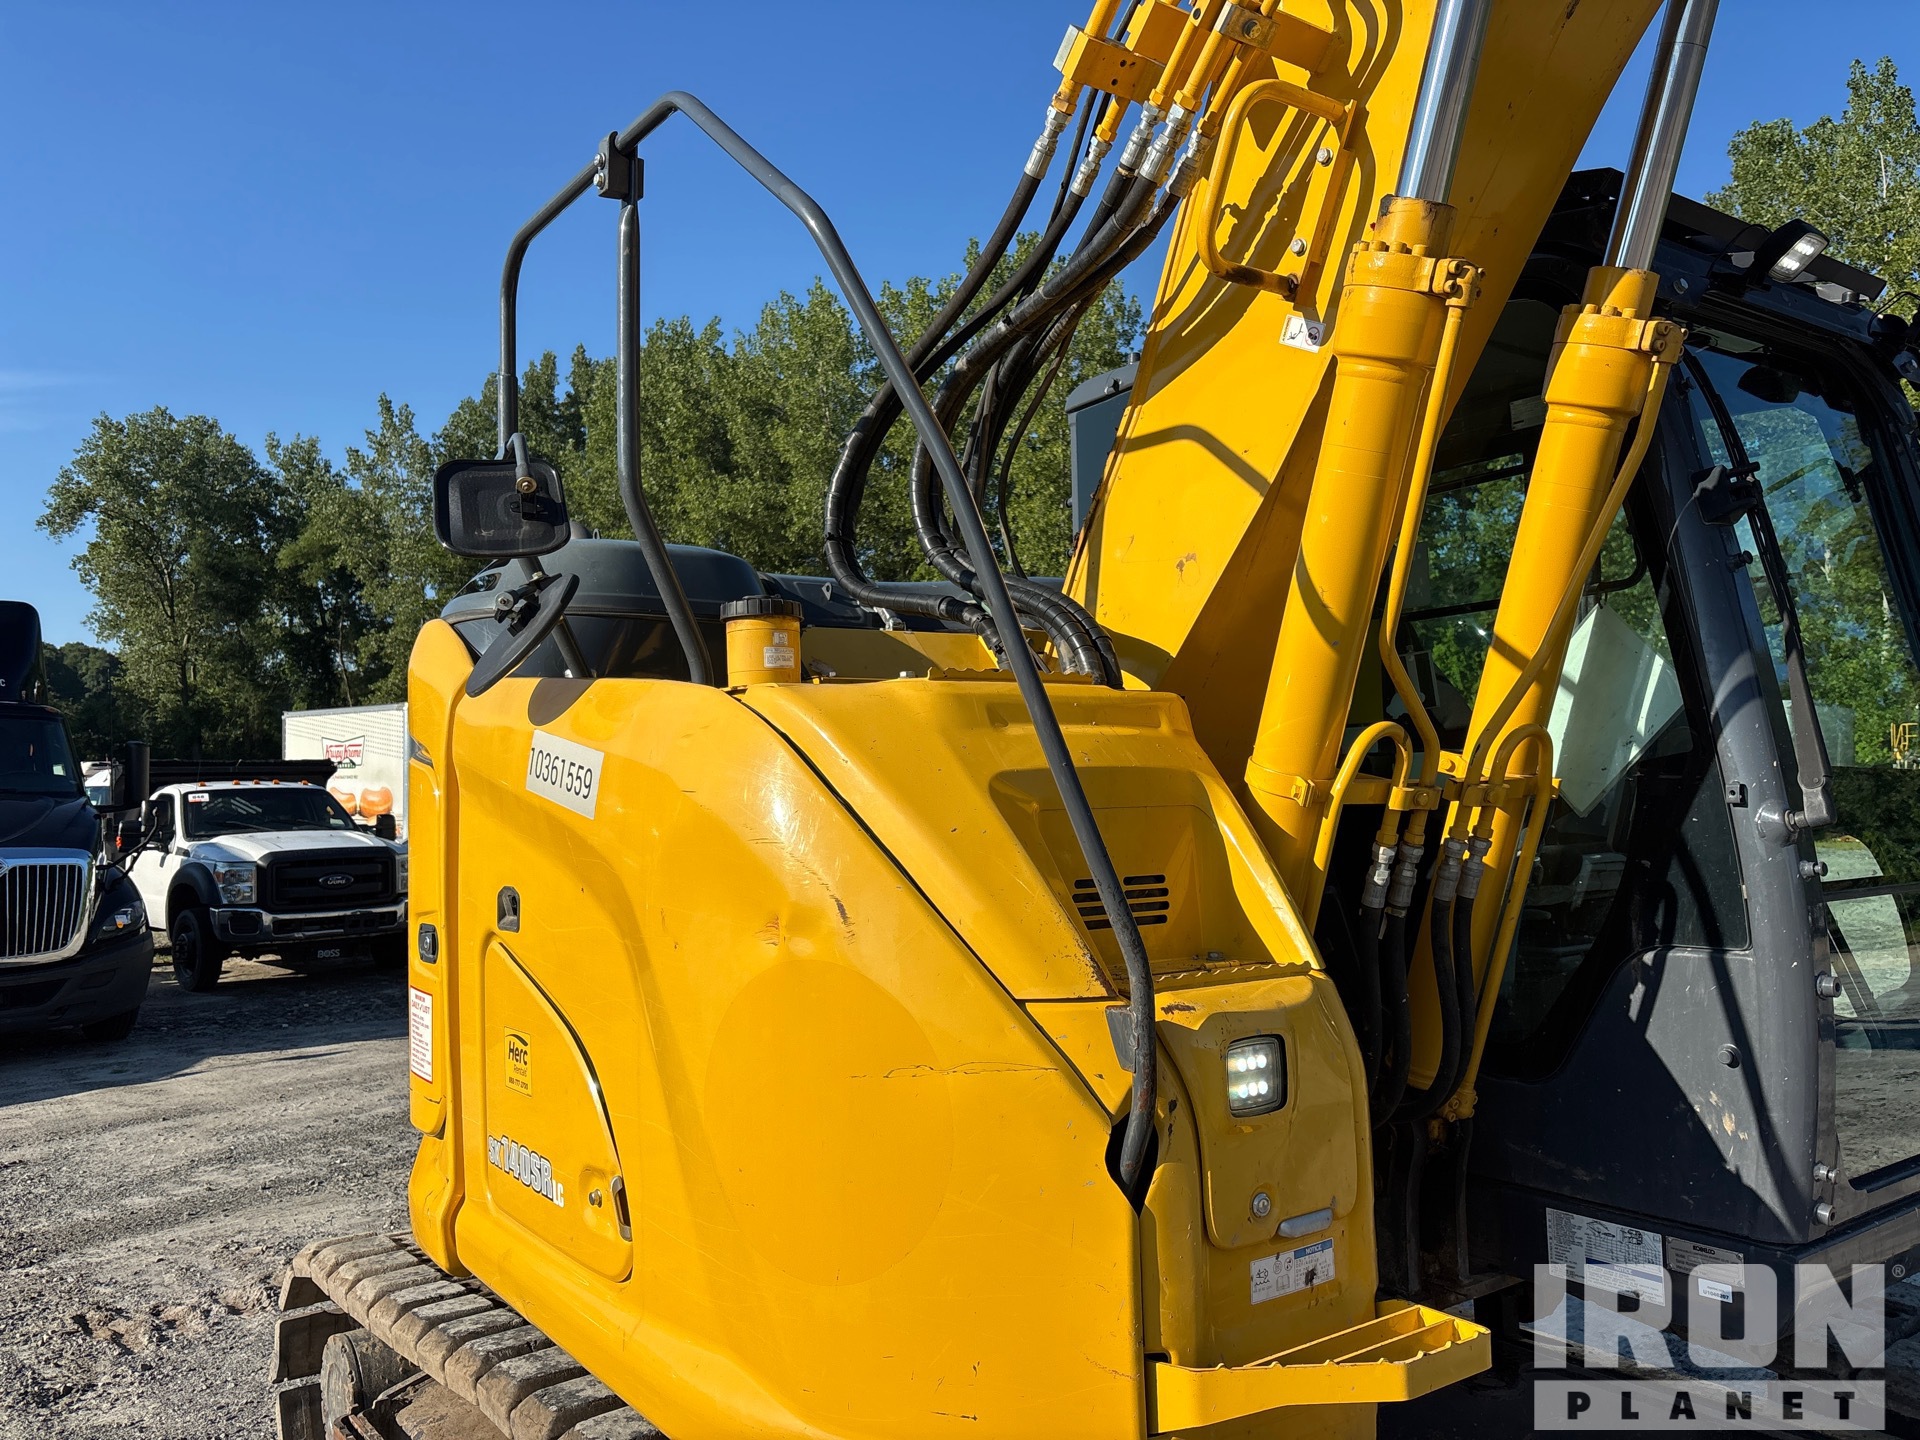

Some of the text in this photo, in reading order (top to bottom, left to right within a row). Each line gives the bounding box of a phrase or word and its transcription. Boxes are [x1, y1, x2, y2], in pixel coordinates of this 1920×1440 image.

[529, 747, 593, 800] 10361559
[327, 876, 347, 885] Ford
[317, 949, 341, 959] BOSS
[508, 1040, 529, 1066] Herc
[1305, 1243, 1323, 1255] NOTICE
[1693, 1245, 1716, 1255] KOBELCO
[1614, 1264, 1633, 1275] NOTICE
